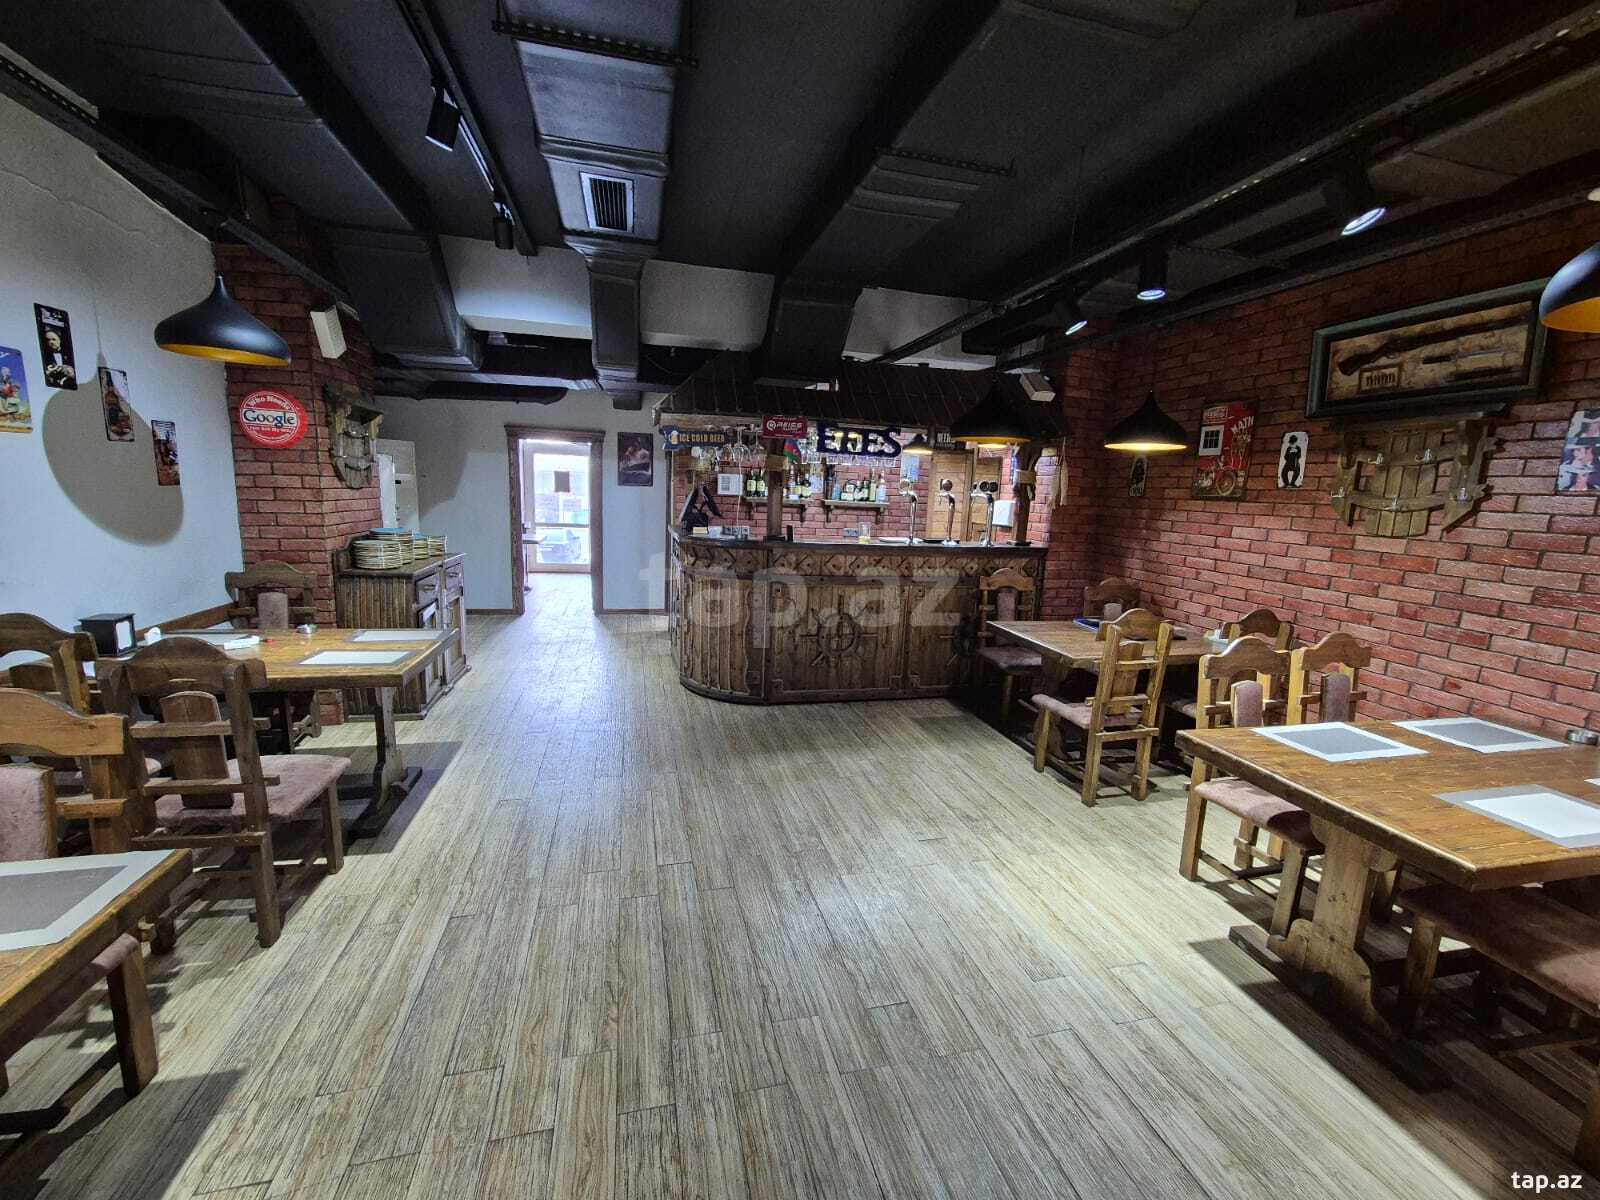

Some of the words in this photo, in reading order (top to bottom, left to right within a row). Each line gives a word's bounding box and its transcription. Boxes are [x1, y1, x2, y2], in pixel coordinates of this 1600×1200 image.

[243, 409, 296, 428] Google
[679, 433, 690, 442] ICE
[691, 433, 708, 442] COLD
